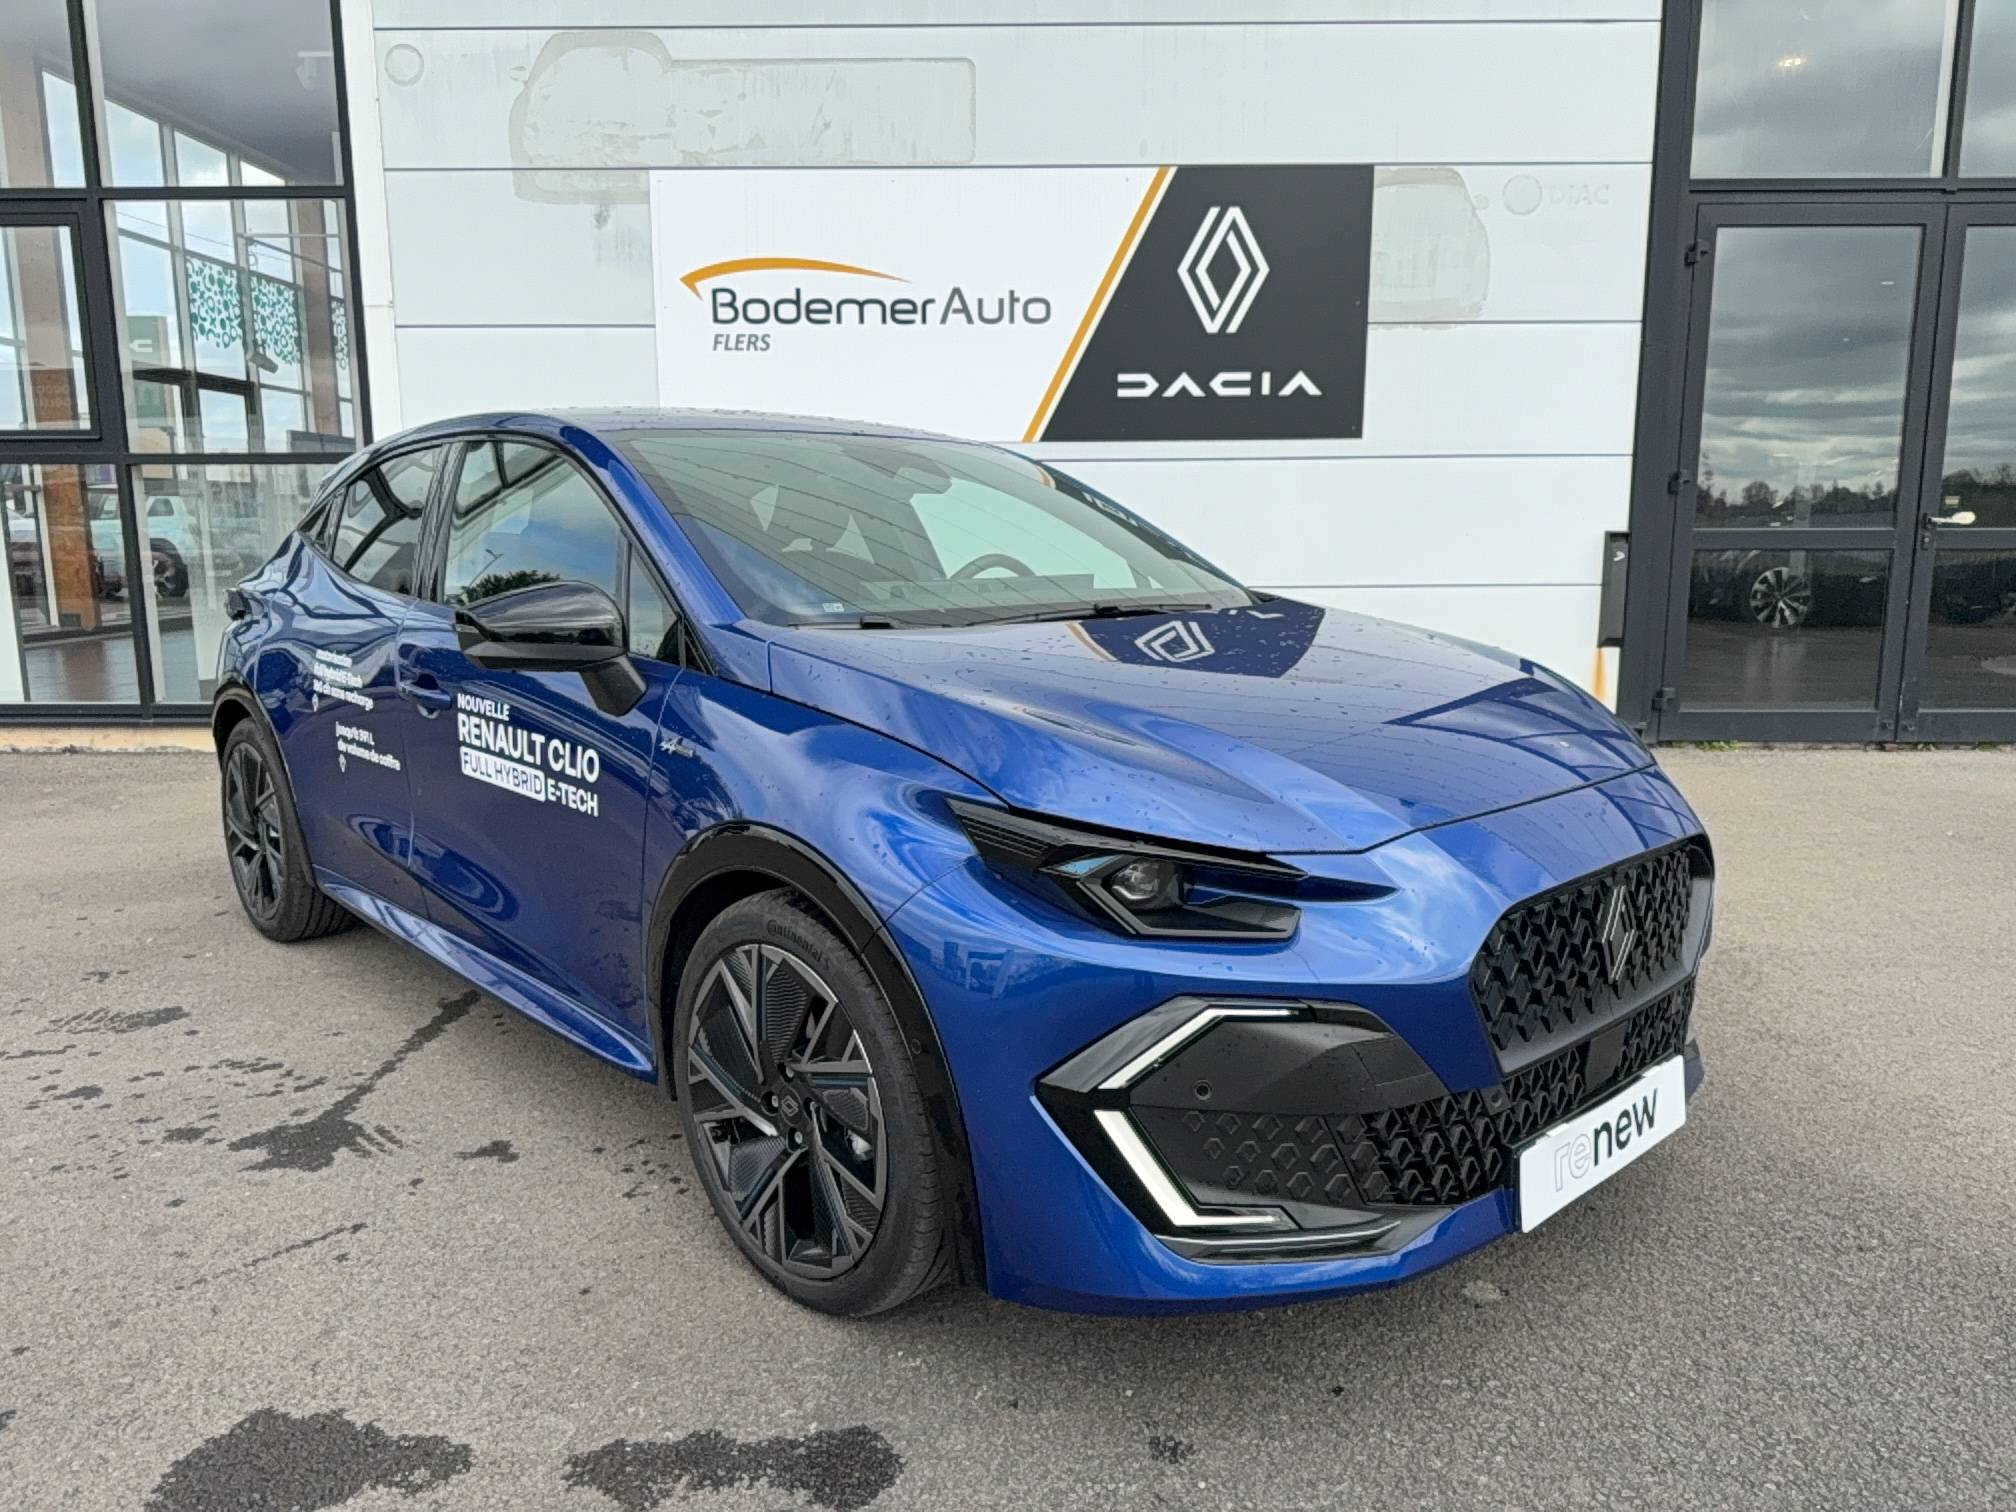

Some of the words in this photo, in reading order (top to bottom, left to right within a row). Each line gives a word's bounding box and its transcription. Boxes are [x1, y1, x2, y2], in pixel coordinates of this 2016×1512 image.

[712, 333, 771, 352] FLERS
[1116, 370, 1323, 398] DACIA
[457, 693, 510, 721] NOUVELLE
[458, 712, 546, 766] RENAULT
[547, 738, 600, 783] CLIO
[463, 751, 493, 779] FULL
[495, 762, 544, 795] HYBRID
[547, 777, 600, 818] E-TECH
[1553, 1087, 1658, 1193] renew
